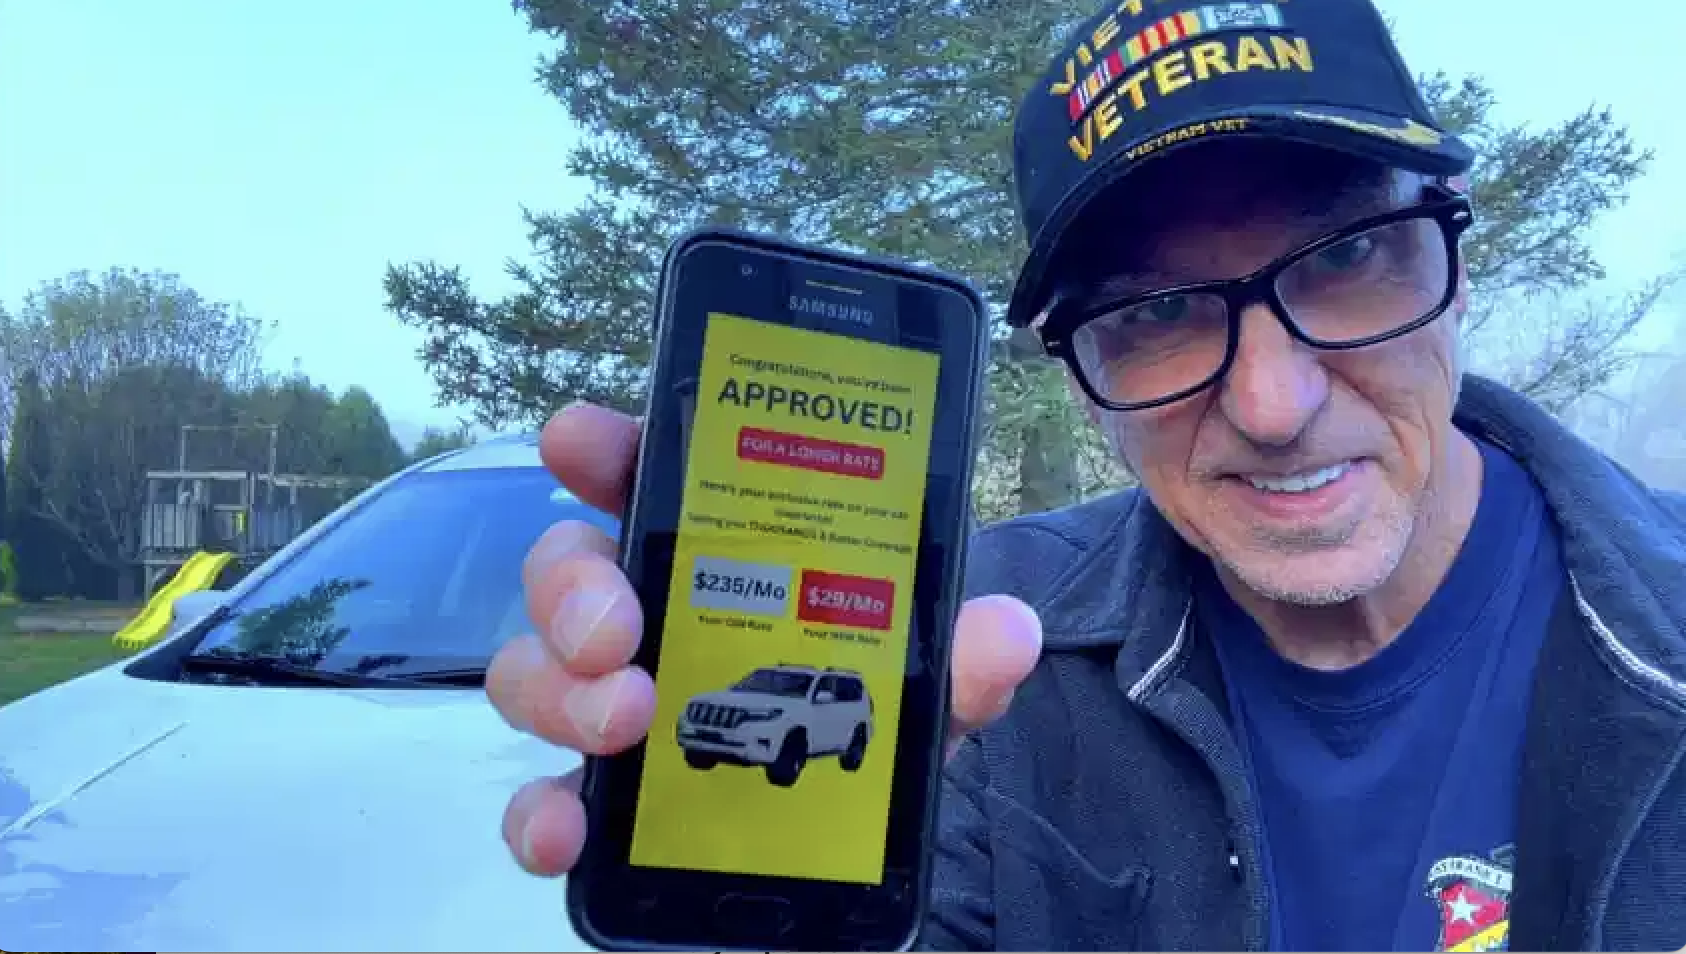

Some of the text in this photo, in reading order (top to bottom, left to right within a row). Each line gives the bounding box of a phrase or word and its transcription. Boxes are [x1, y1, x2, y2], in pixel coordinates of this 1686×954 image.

[1068, 36, 1314, 162] VETERAN
[789, 295, 874, 327] SAMSUNG
[717, 377, 914, 436] APPROVED!
[843, 449, 880, 472] RATE
[694, 570, 788, 602] $235/Mo
[806, 584, 887, 614] $29/Mo
